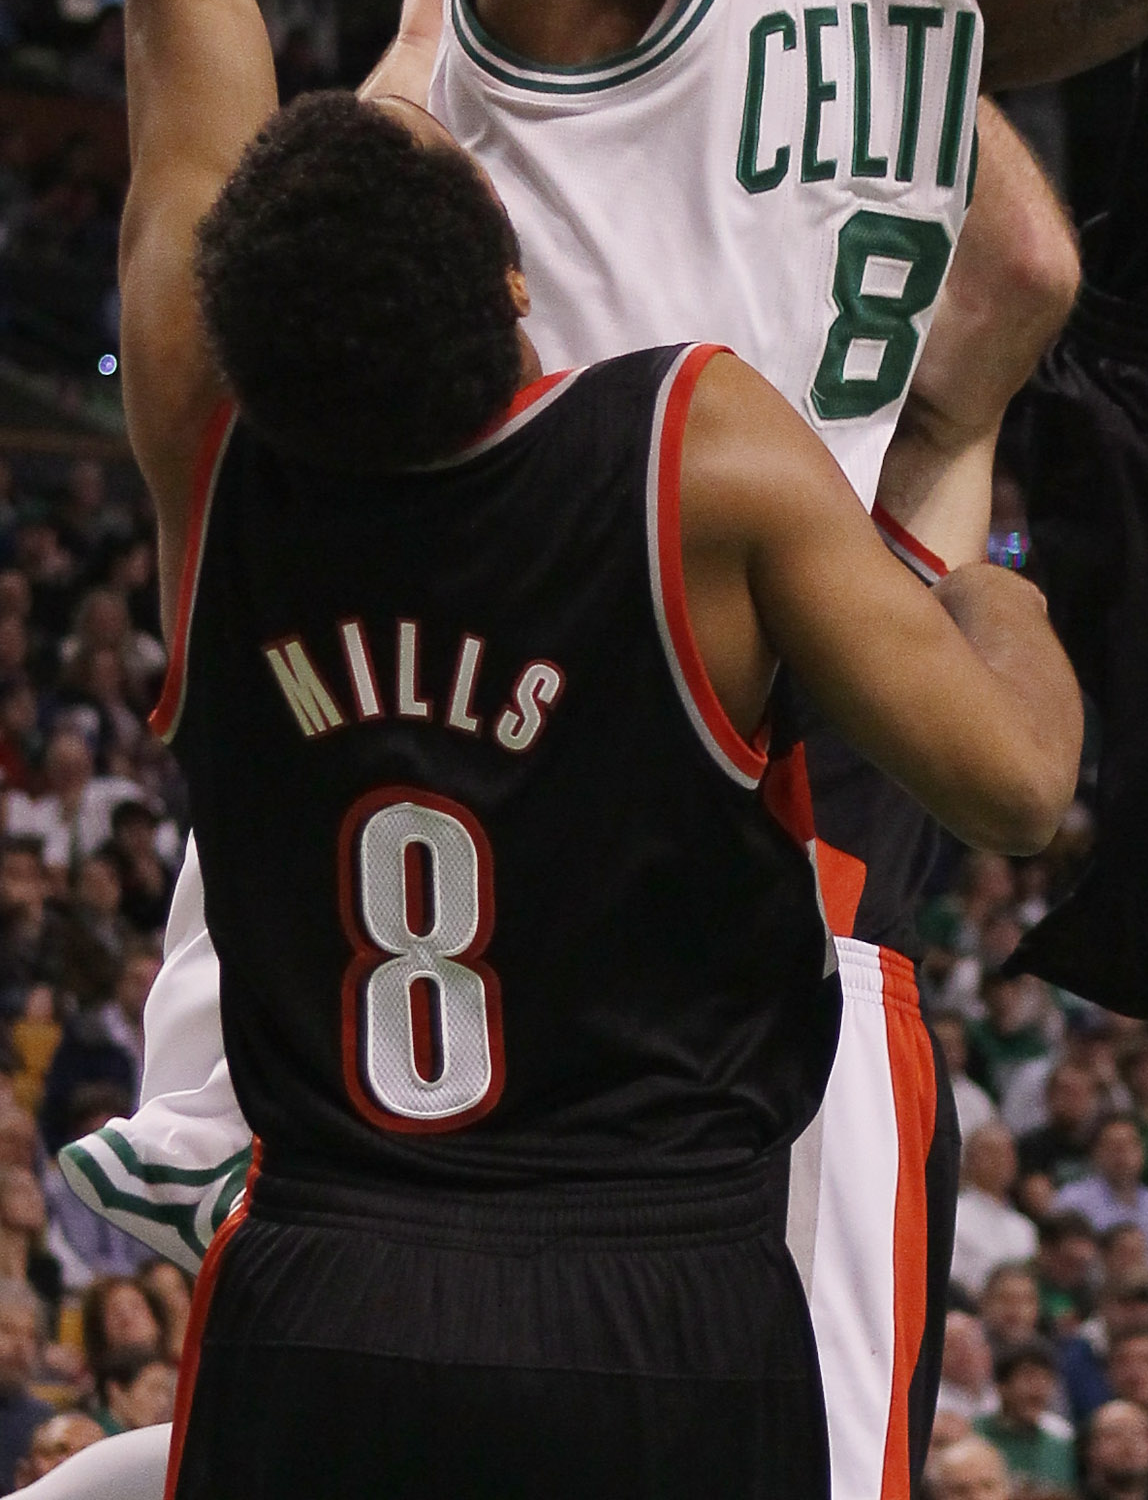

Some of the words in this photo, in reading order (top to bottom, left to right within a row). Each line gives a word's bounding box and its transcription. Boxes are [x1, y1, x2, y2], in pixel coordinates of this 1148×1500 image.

[736, 3, 980, 210] CELTI
[808, 207, 955, 422] 8
[262, 613, 567, 753] MILLS
[338, 784, 506, 1134] 8
